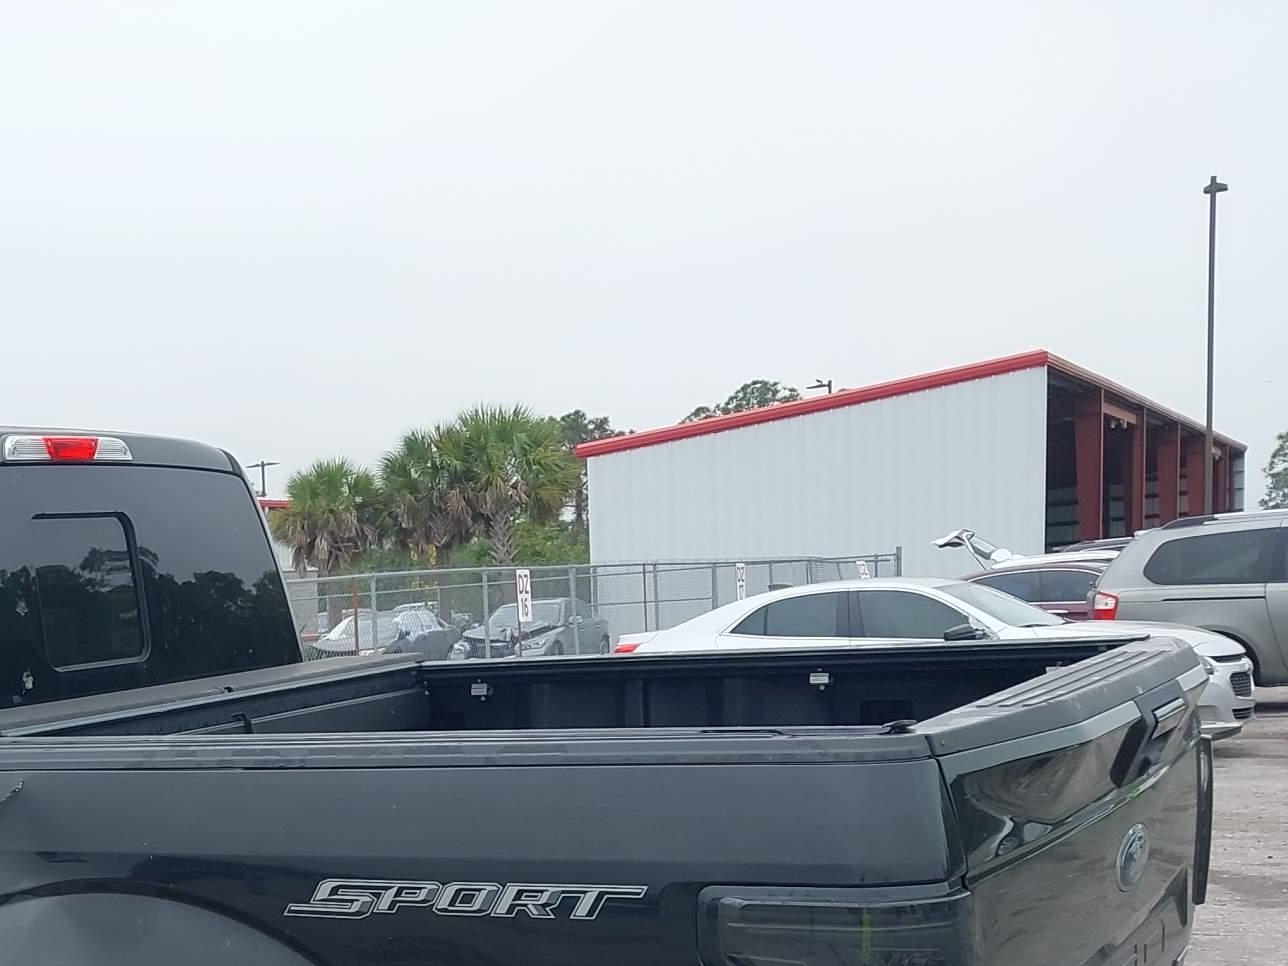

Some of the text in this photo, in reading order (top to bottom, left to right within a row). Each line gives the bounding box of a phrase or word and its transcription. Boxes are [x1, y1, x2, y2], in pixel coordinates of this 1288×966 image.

[518, 574, 530, 595] DZ
[521, 597, 530, 618] 16
[283, 878, 648, 920] SPORT
